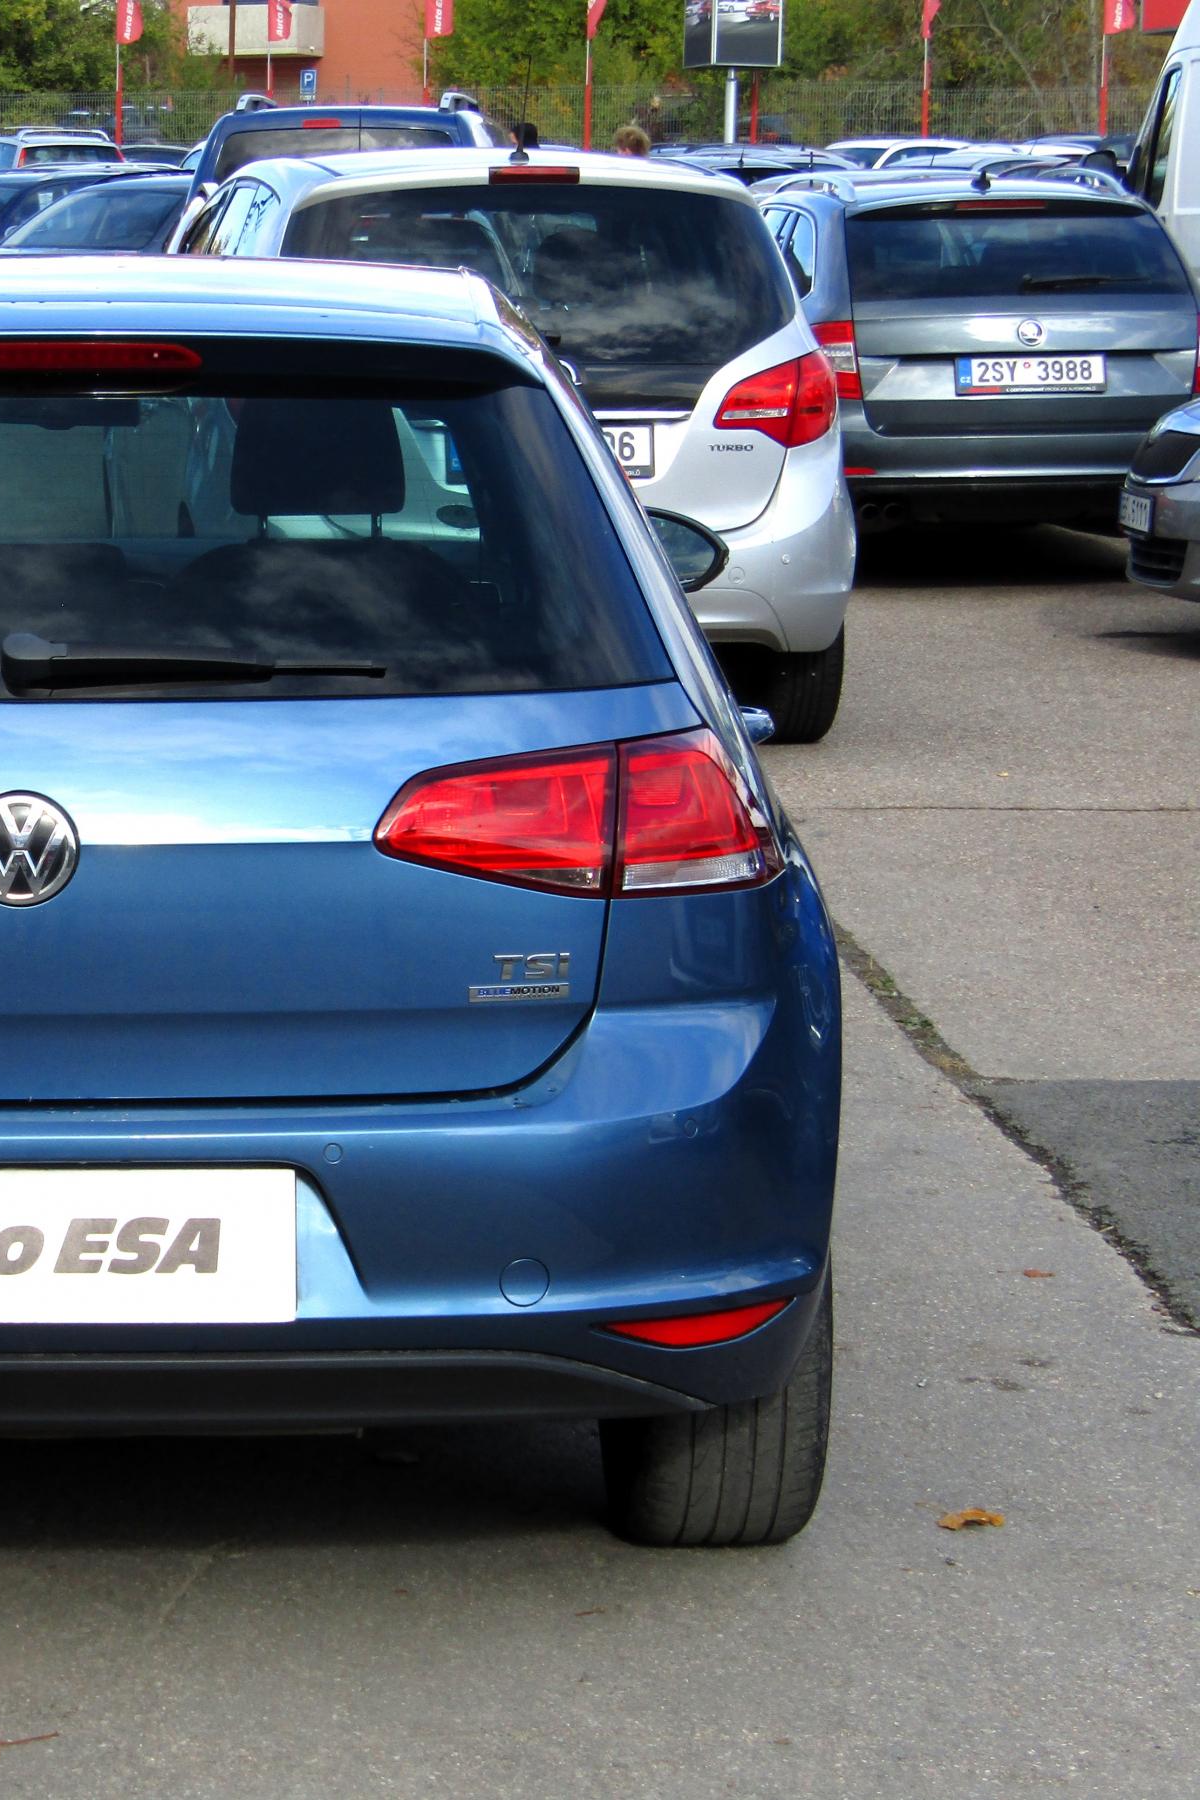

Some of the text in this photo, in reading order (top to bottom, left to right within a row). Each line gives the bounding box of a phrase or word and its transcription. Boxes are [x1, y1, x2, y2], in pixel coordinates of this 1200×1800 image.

[124, 15, 134, 40] Auto
[275, 12, 285, 37] Auto
[434, 9, 444, 34] Auto
[1113, 2, 1124, 29] Auto
[304, 73, 313, 86] P
[977, 360, 1092, 382] 2SY 3988
[708, 444, 754, 452] TURBO
[493, 953, 570, 981] TSI
[53, 1217, 222, 1276] ESA
